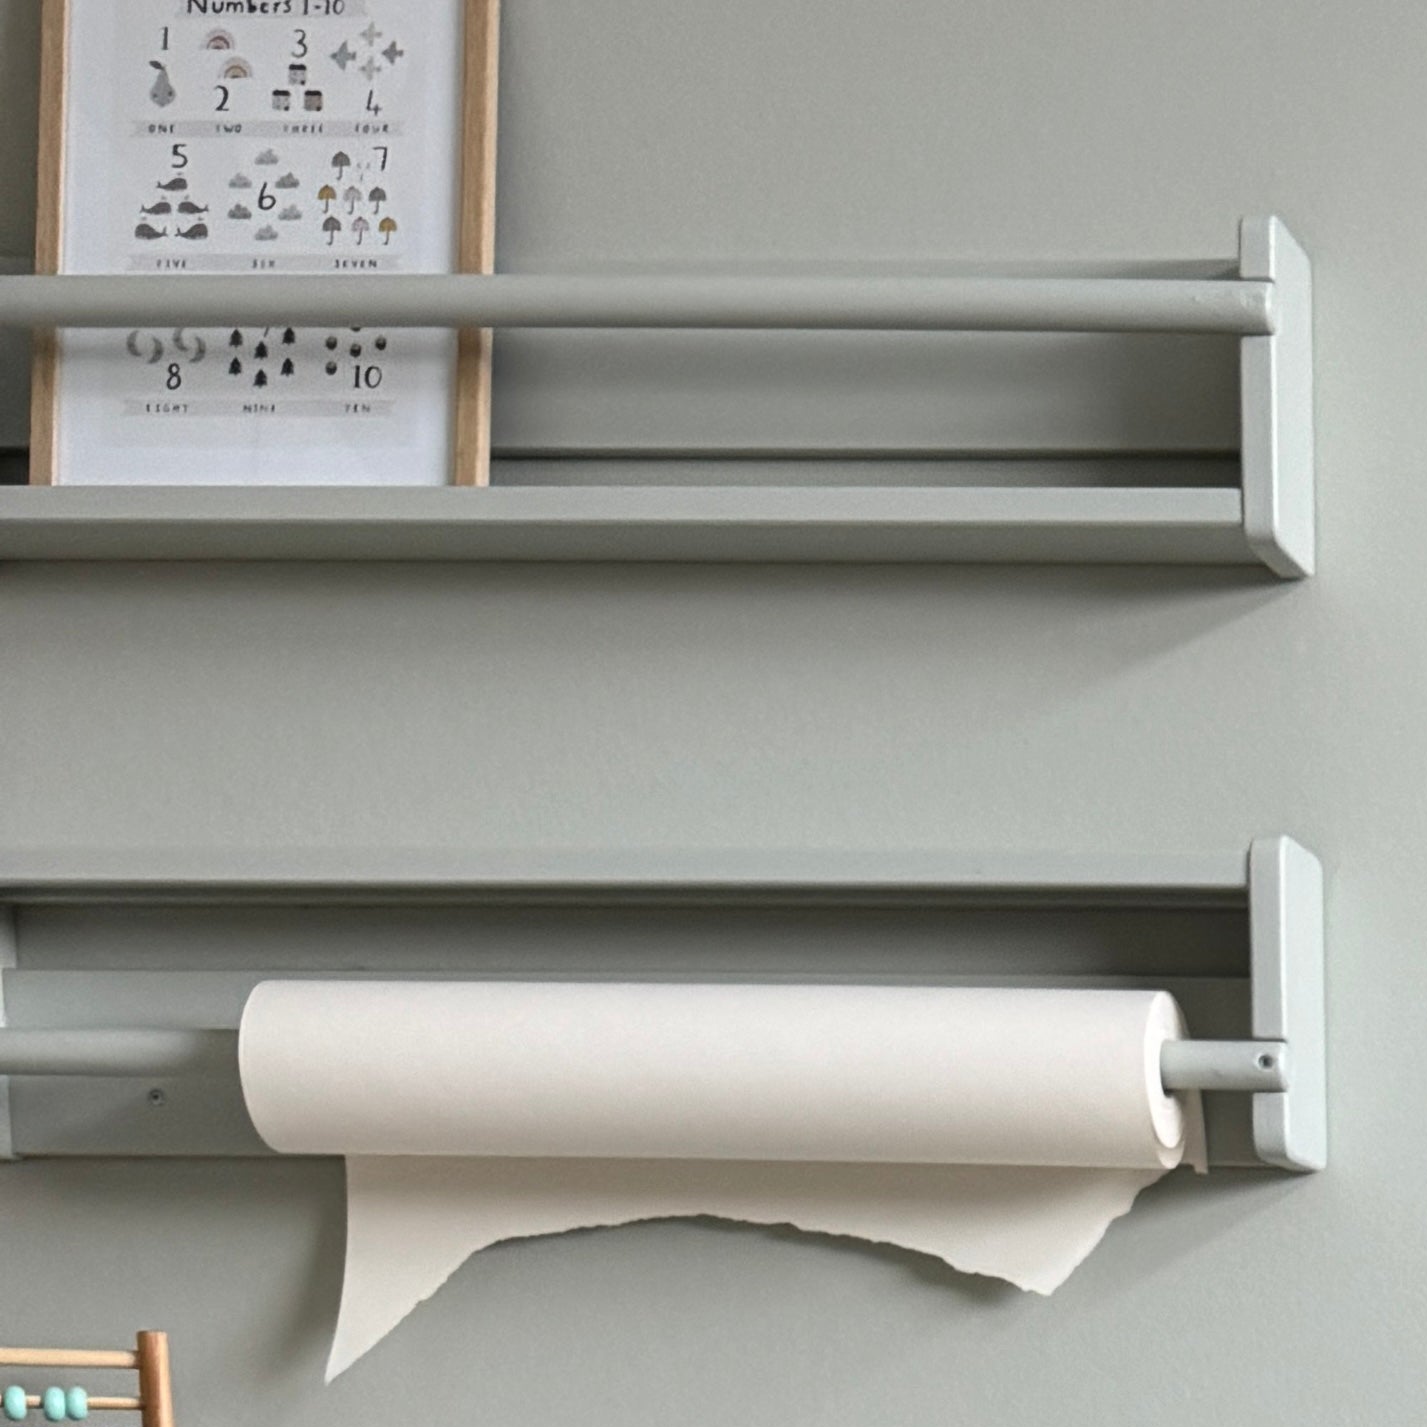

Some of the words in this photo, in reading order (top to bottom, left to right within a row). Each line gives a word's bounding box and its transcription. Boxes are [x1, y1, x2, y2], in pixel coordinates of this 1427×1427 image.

[187, 0, 292, 13] Numbers
[303, 0, 345, 15] 1-10
[162, 27, 168, 50] 1
[292, 29, 308, 58] 3
[215, 85, 229, 111] 2
[366, 90, 382, 115] 4
[171, 144, 188, 168] 5
[372, 146, 388, 171] 7
[257, 181, 276, 210] 6
[166, 363, 182, 390] 8
[353, 365, 382, 389] 10
